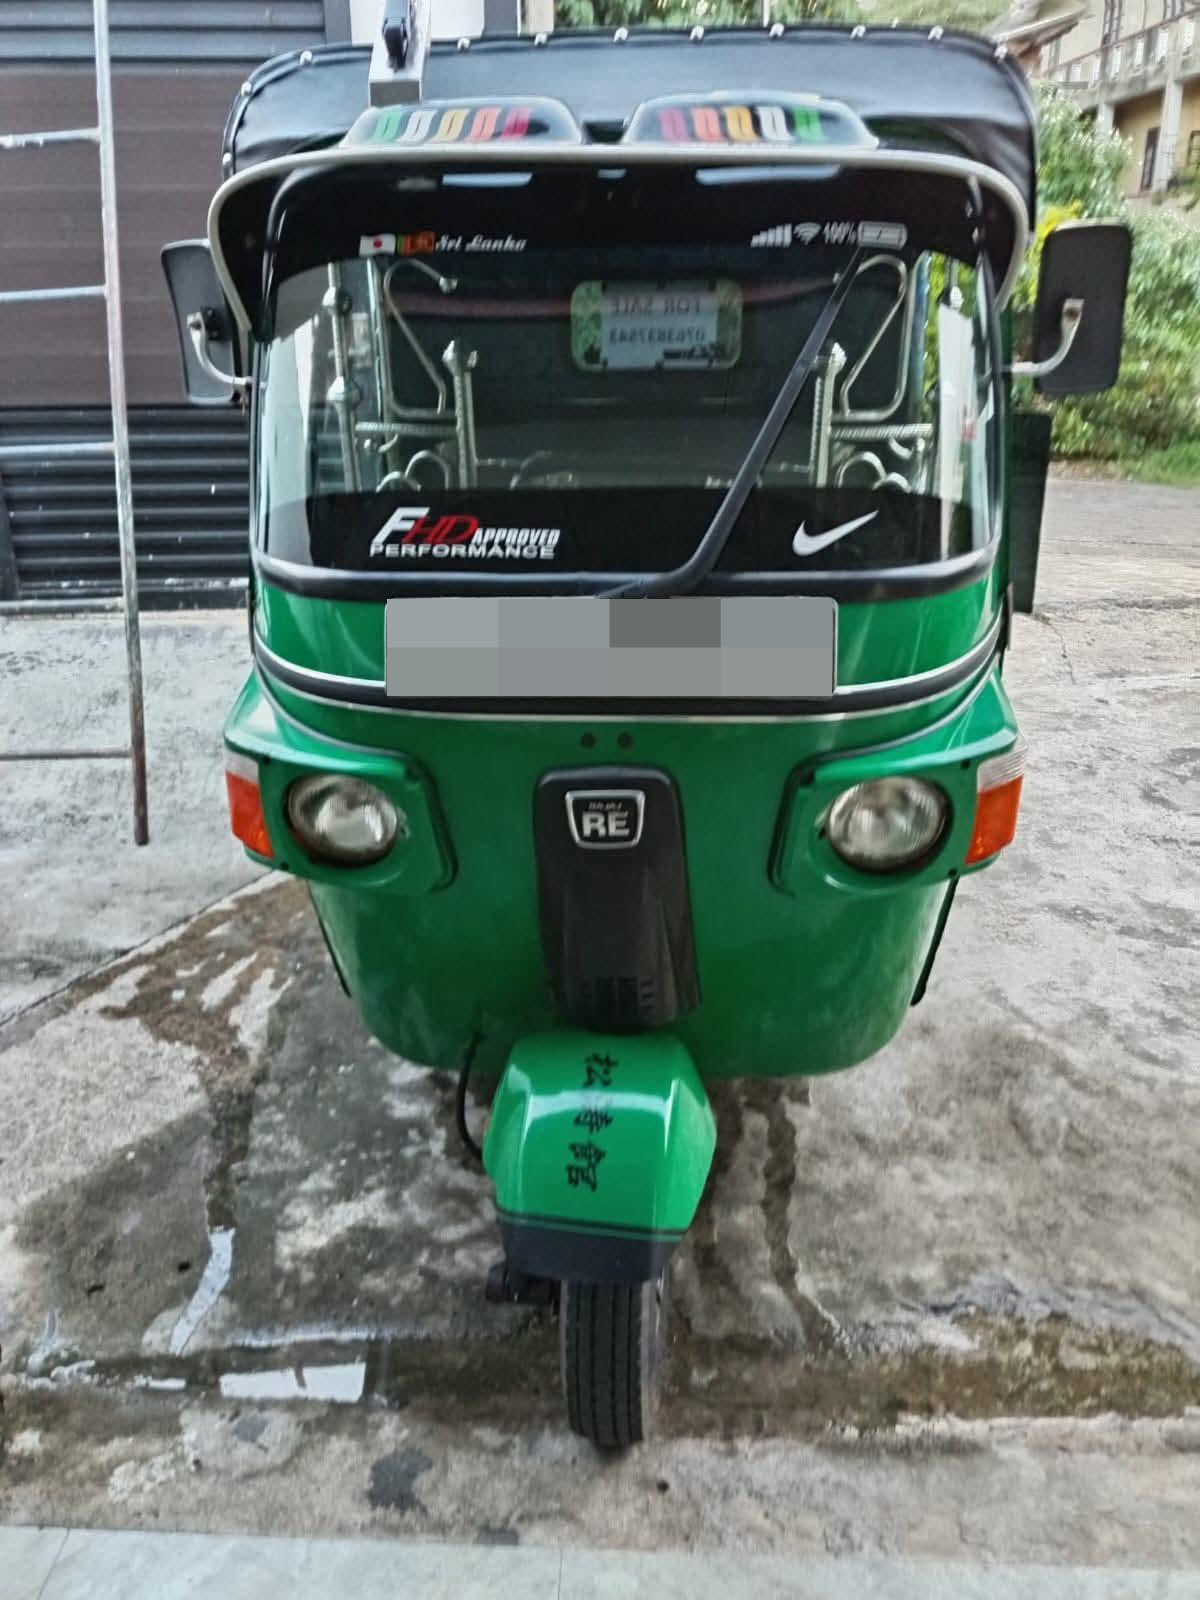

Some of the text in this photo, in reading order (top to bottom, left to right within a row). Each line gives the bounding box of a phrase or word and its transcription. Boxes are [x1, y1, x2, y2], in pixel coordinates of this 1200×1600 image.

[435, 234, 529, 252] Sri Lanka
[472, 528, 561, 546] APPROVED
[369, 543, 555, 560] PERFORMANCE
[582, 810, 630, 838] RE
